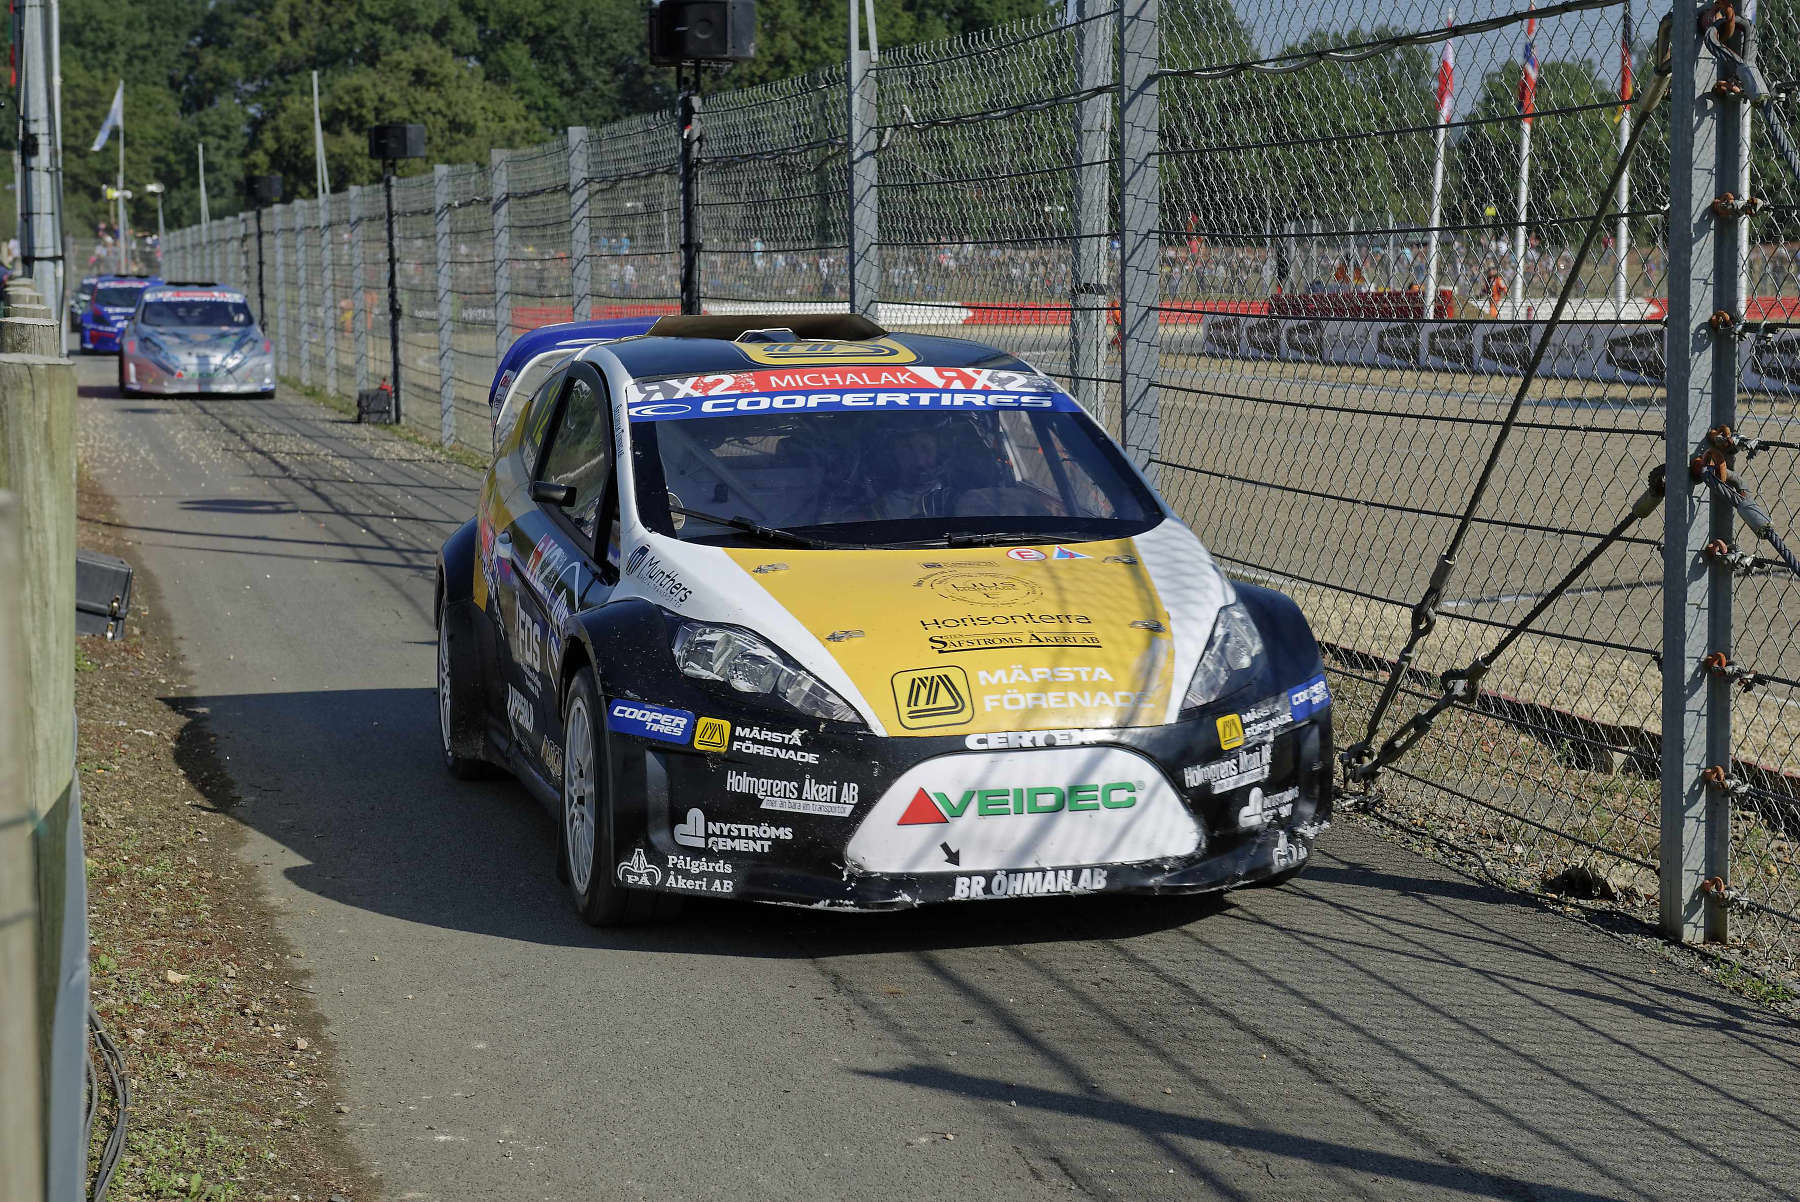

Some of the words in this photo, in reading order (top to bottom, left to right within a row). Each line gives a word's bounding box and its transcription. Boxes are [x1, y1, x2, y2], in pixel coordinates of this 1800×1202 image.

[769, 371, 917, 388] MICHALAK
[638, 555, 692, 602] Munthers
[920, 612, 1093, 631] Horisonterra
[977, 664, 1115, 686] MÄRSTA
[983, 689, 1156, 713] FÖRENADE
[612, 705, 689, 728] COOPER
[645, 721, 685, 737] TIRES
[734, 726, 803, 747] MÄRSTA
[732, 741, 821, 765] FÖRENADE
[726, 770, 798, 799] Holmgrens
[802, 774, 838, 804] Åkeri
[840, 782, 860, 805] AB
[933, 782, 1137, 818] VEIDEC
[707, 821, 793, 840] NYSTRÖMS
[707, 836, 772, 853] CEMENT
[667, 855, 733, 875] Pålgårds
[665, 870, 707, 891] Åkeri
[710, 880, 735, 893] AB
[955, 875, 987, 899] BR
